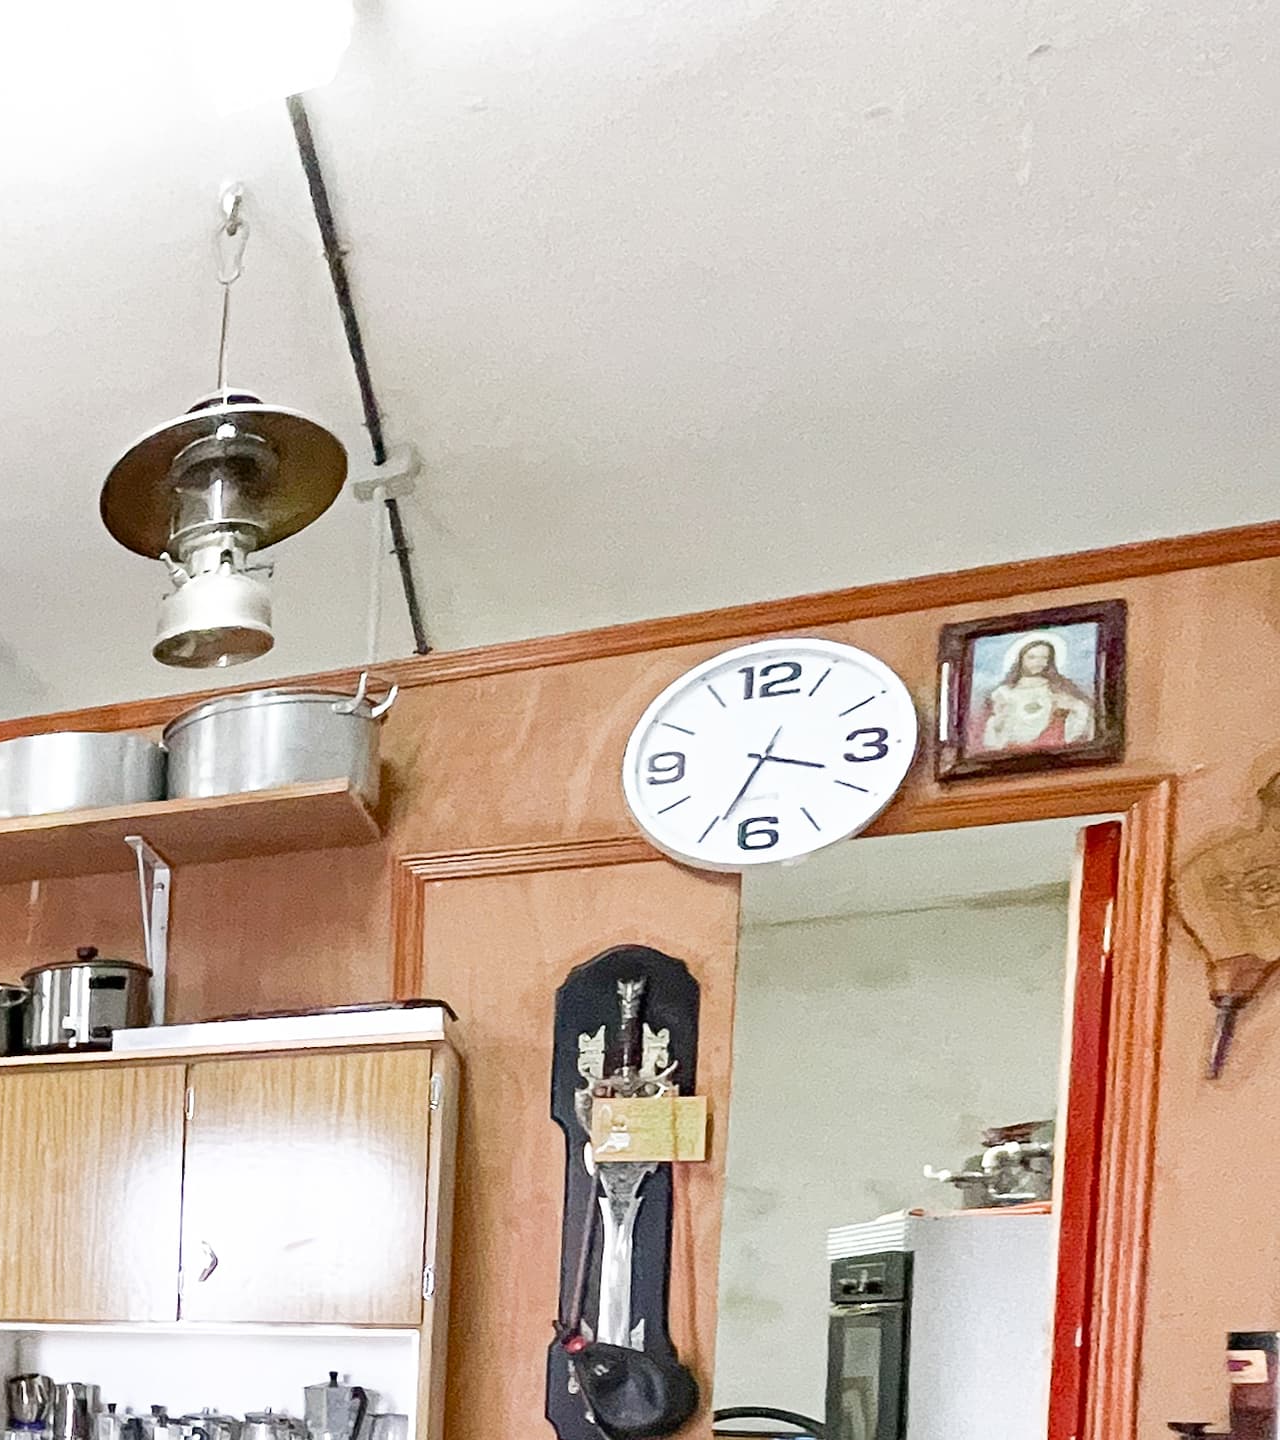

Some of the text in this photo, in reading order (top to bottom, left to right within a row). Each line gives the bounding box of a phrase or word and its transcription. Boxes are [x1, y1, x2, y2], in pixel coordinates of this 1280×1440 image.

[738, 661, 803, 701] 12
[646, 726, 890, 786] 9 3
[737, 815, 780, 851] 6
